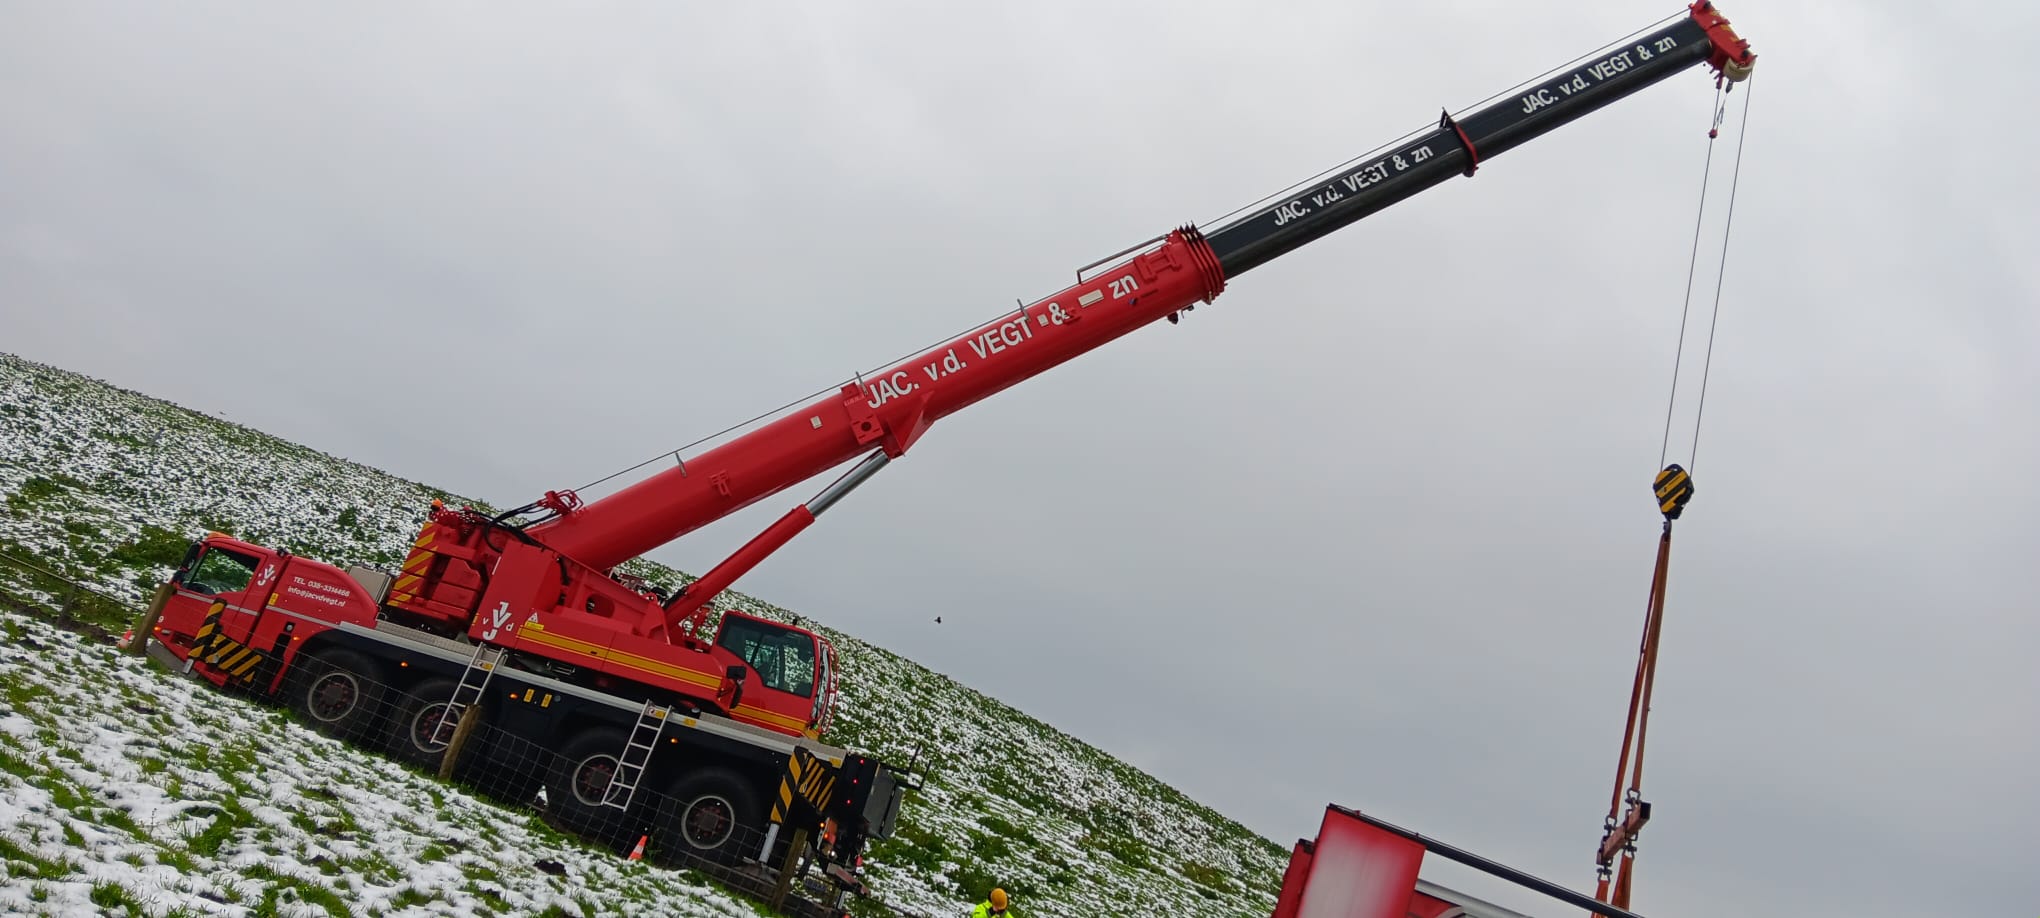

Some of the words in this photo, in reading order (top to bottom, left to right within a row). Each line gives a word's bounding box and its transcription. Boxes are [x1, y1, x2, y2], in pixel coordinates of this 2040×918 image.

[1522, 88, 1559, 114] JAC.
[1559, 74, 1591, 96] v.d.
[1588, 51, 1634, 81] VEGT
[1636, 45, 1654, 61] &
[1654, 36, 1678, 53] zn
[1274, 200, 1311, 226] JAC.
[1312, 184, 1344, 207] v.d.
[1342, 161, 1389, 193] VEGT
[1392, 154, 1410, 171] &
[1411, 145, 1434, 163] zn
[867, 371, 920, 409] JAC.
[923, 349, 967, 381] v.d.
[967, 316, 1033, 360] VEGT
[1048, 302, 1071, 326] &
[1108, 274, 1139, 300] zn
